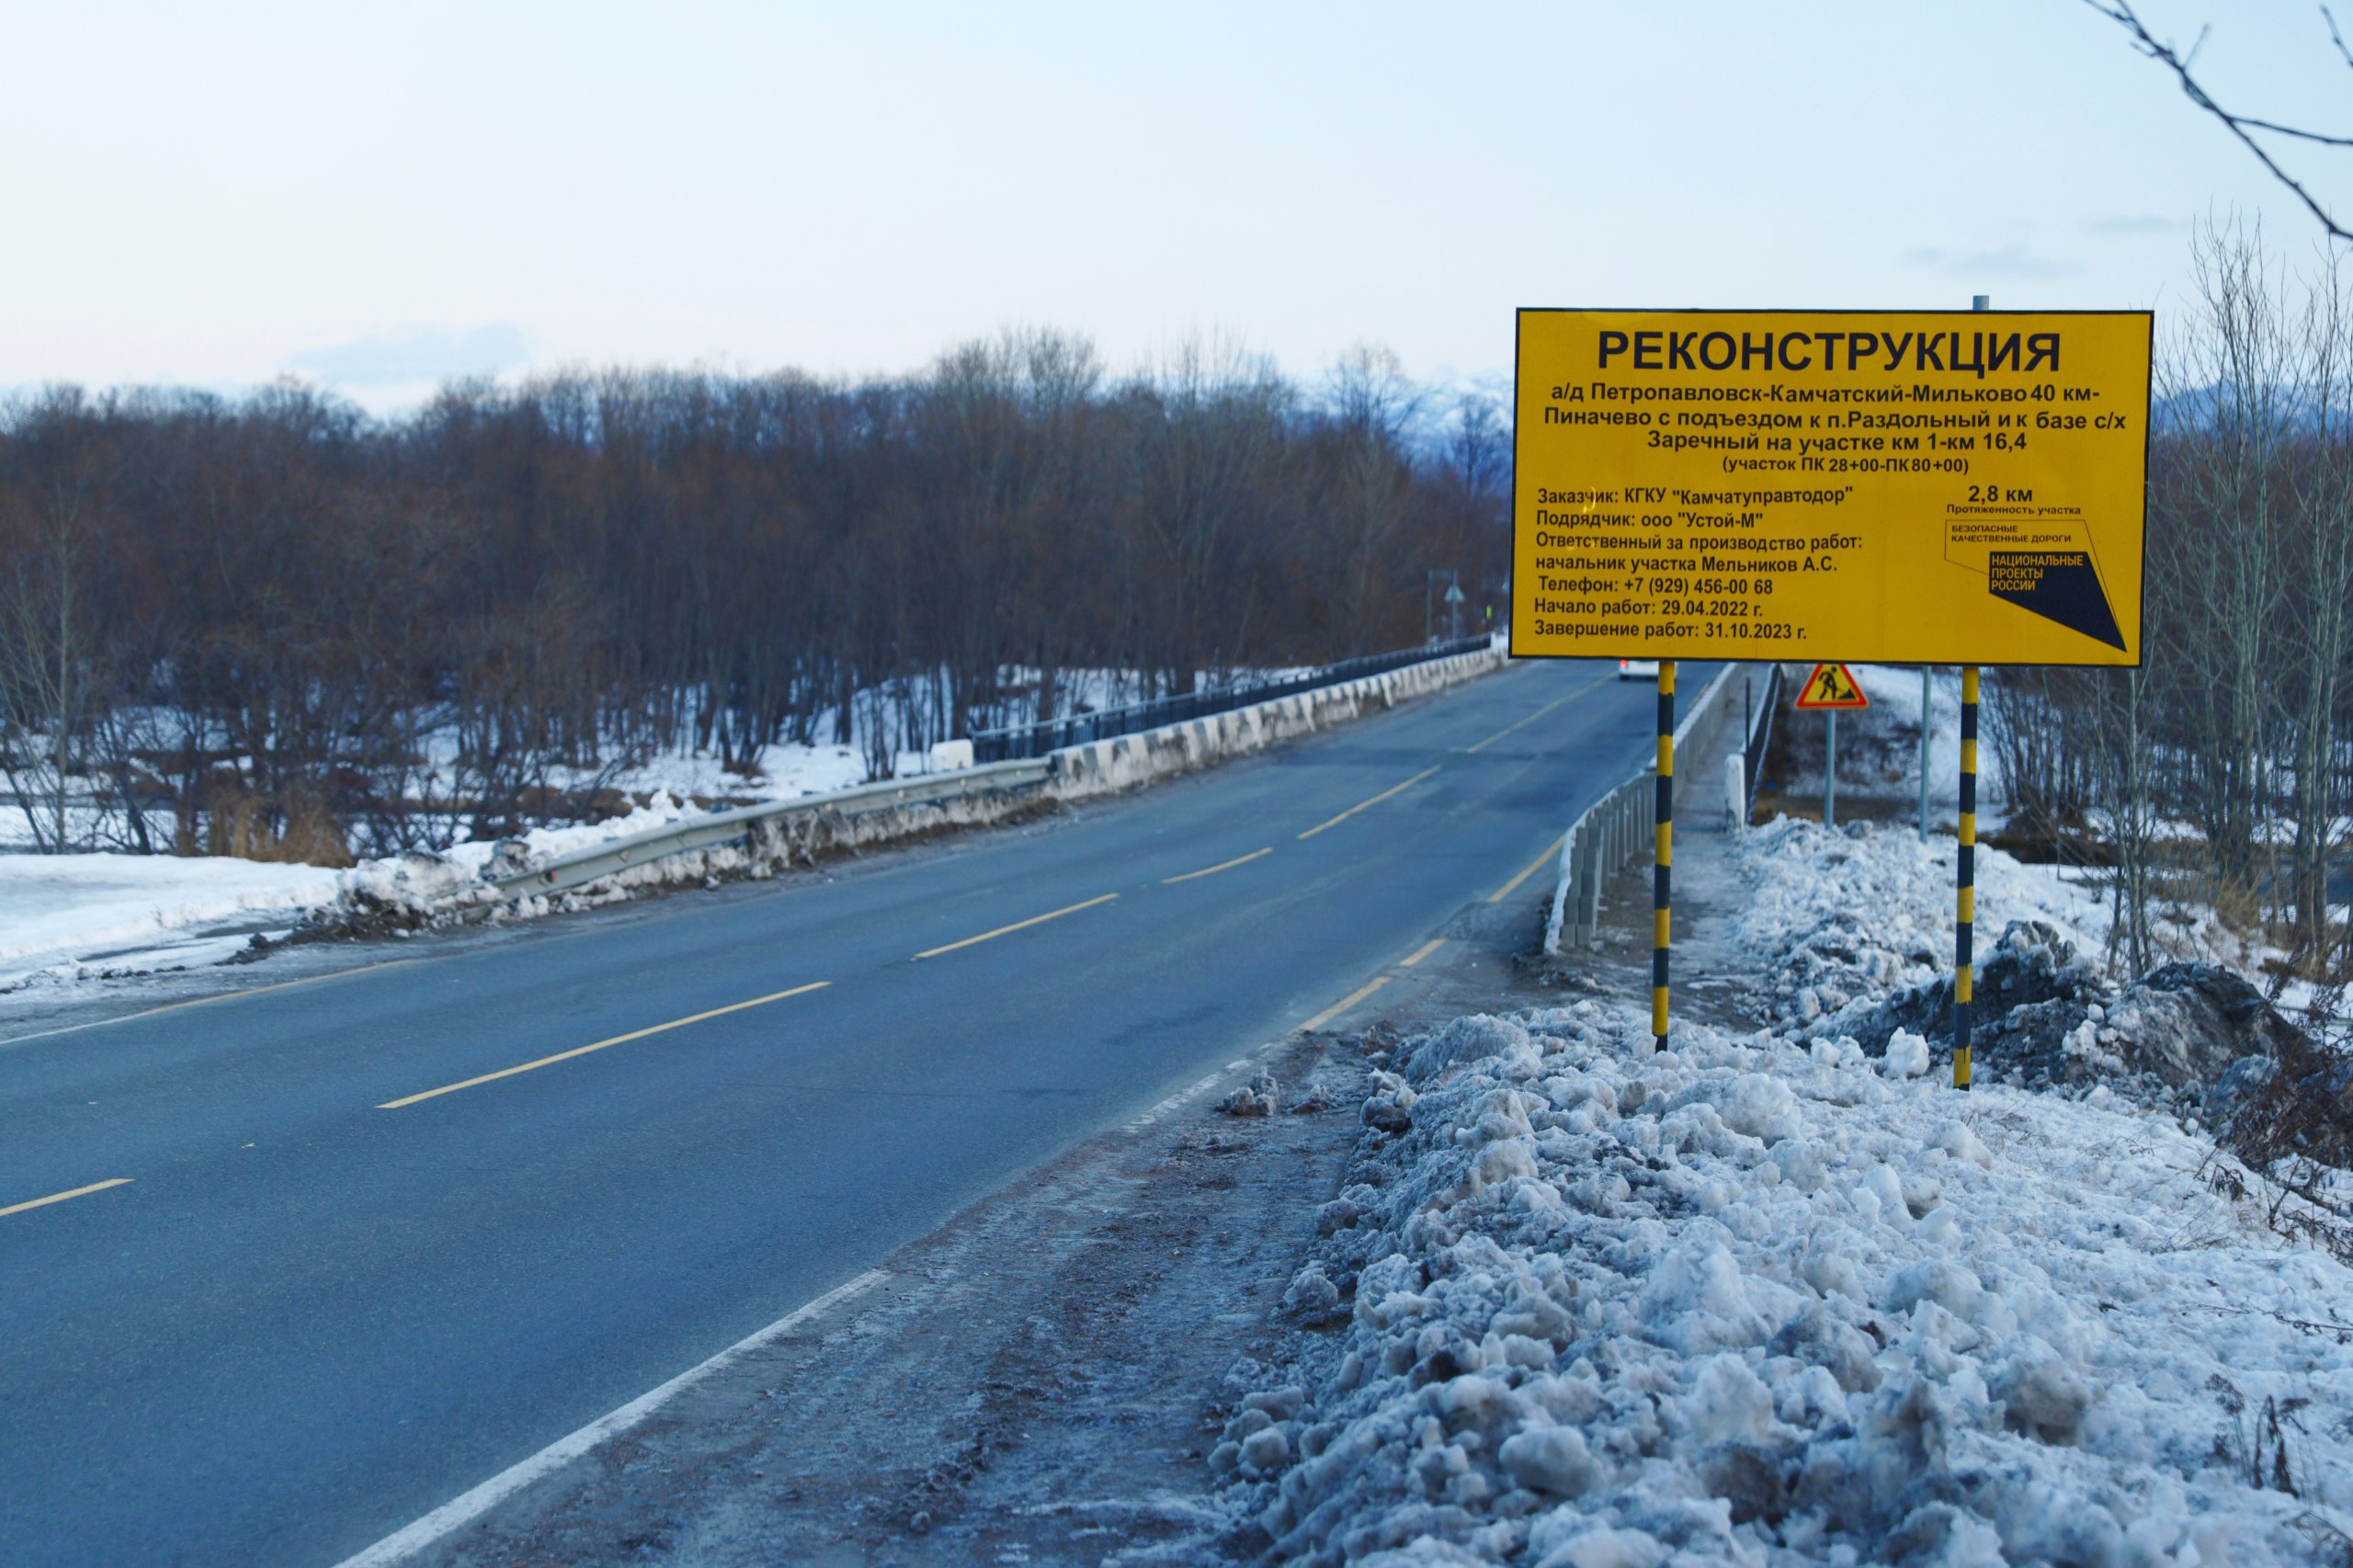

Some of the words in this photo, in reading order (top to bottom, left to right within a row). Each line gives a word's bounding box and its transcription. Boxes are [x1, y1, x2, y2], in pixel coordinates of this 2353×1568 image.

[1598, 331, 2061, 379] РЕКОНСТРУКЦИЯ
[1552, 382, 1584, 402] а/д
[2063, 387, 2099, 401] км-
[1545, 408, 1652, 425] Пиначево
[1658, 413, 1670, 425] с
[1677, 413, 1802, 428] подъездом
[1810, 415, 1820, 427] к
[1828, 411, 1990, 428] п.Раздольный
[1998, 414, 2010, 427] и
[2017, 415, 2027, 427] к
[2037, 413, 2087, 428] базе
[2095, 412, 2125, 428] с/х
[1648, 430, 1758, 451] Заречный
[1768, 437, 1791, 450] на
[1799, 435, 1884, 455] участке
[1892, 437, 1919, 450] км
[1927, 435, 1974, 450] 1-км
[1984, 433, 2026, 452] 16,4
[1722, 456, 1796, 472] (участок
[1802, 457, 1824, 472] ПК
[1538, 488, 1619, 504] Заказчик:
[1625, 488, 1665, 503] КГКУ
[1673, 486, 1853, 507] "Камчатуправтодор"
[1968, 485, 1998, 505] 2,8
[2006, 489, 2032, 502] км
[1537, 510, 1635, 528] Подрядчик:
[1642, 516, 1672, 527] ооо
[1678, 512, 1763, 528] "Устой-М"
[1947, 505, 2035, 515] Протяженность
[2039, 506, 2081, 516] участка
[1537, 532, 1661, 549] Ответственный
[1666, 538, 1683, 549] за
[1689, 538, 1805, 552] производство
[1811, 534, 1862, 552] работ:
[2031, 535, 2071, 543] ДОРОГИ
[1536, 557, 1625, 570] начальник
[1631, 559, 1696, 574] участка
[1702, 556, 1797, 572] Мельников
[1803, 556, 1837, 571] А.С.
[1992, 555, 2083, 567] НАЦИОНАЛЬНЫЕ
[1992, 568, 2042, 579] ПРОЕКТЫ
[1539, 575, 1619, 595] Телефон:
[1625, 578, 1643, 592] +7
[1649, 578, 1688, 597] (929)
[1694, 579, 1747, 594] 456-00
[1754, 579, 1772, 594] 68
[1991, 580, 2035, 591] РОССИИ
[1535, 598, 1596, 613] Начало
[1601, 599, 1655, 617] работ:
[1662, 599, 1747, 616] 29.04.2022
[1754, 605, 1763, 616] г.
[1535, 619, 1639, 638] Завершение
[1645, 622, 1699, 639] работ:
[1705, 622, 1791, 639] 31.10.2023
[1797, 627, 1806, 639] г.
